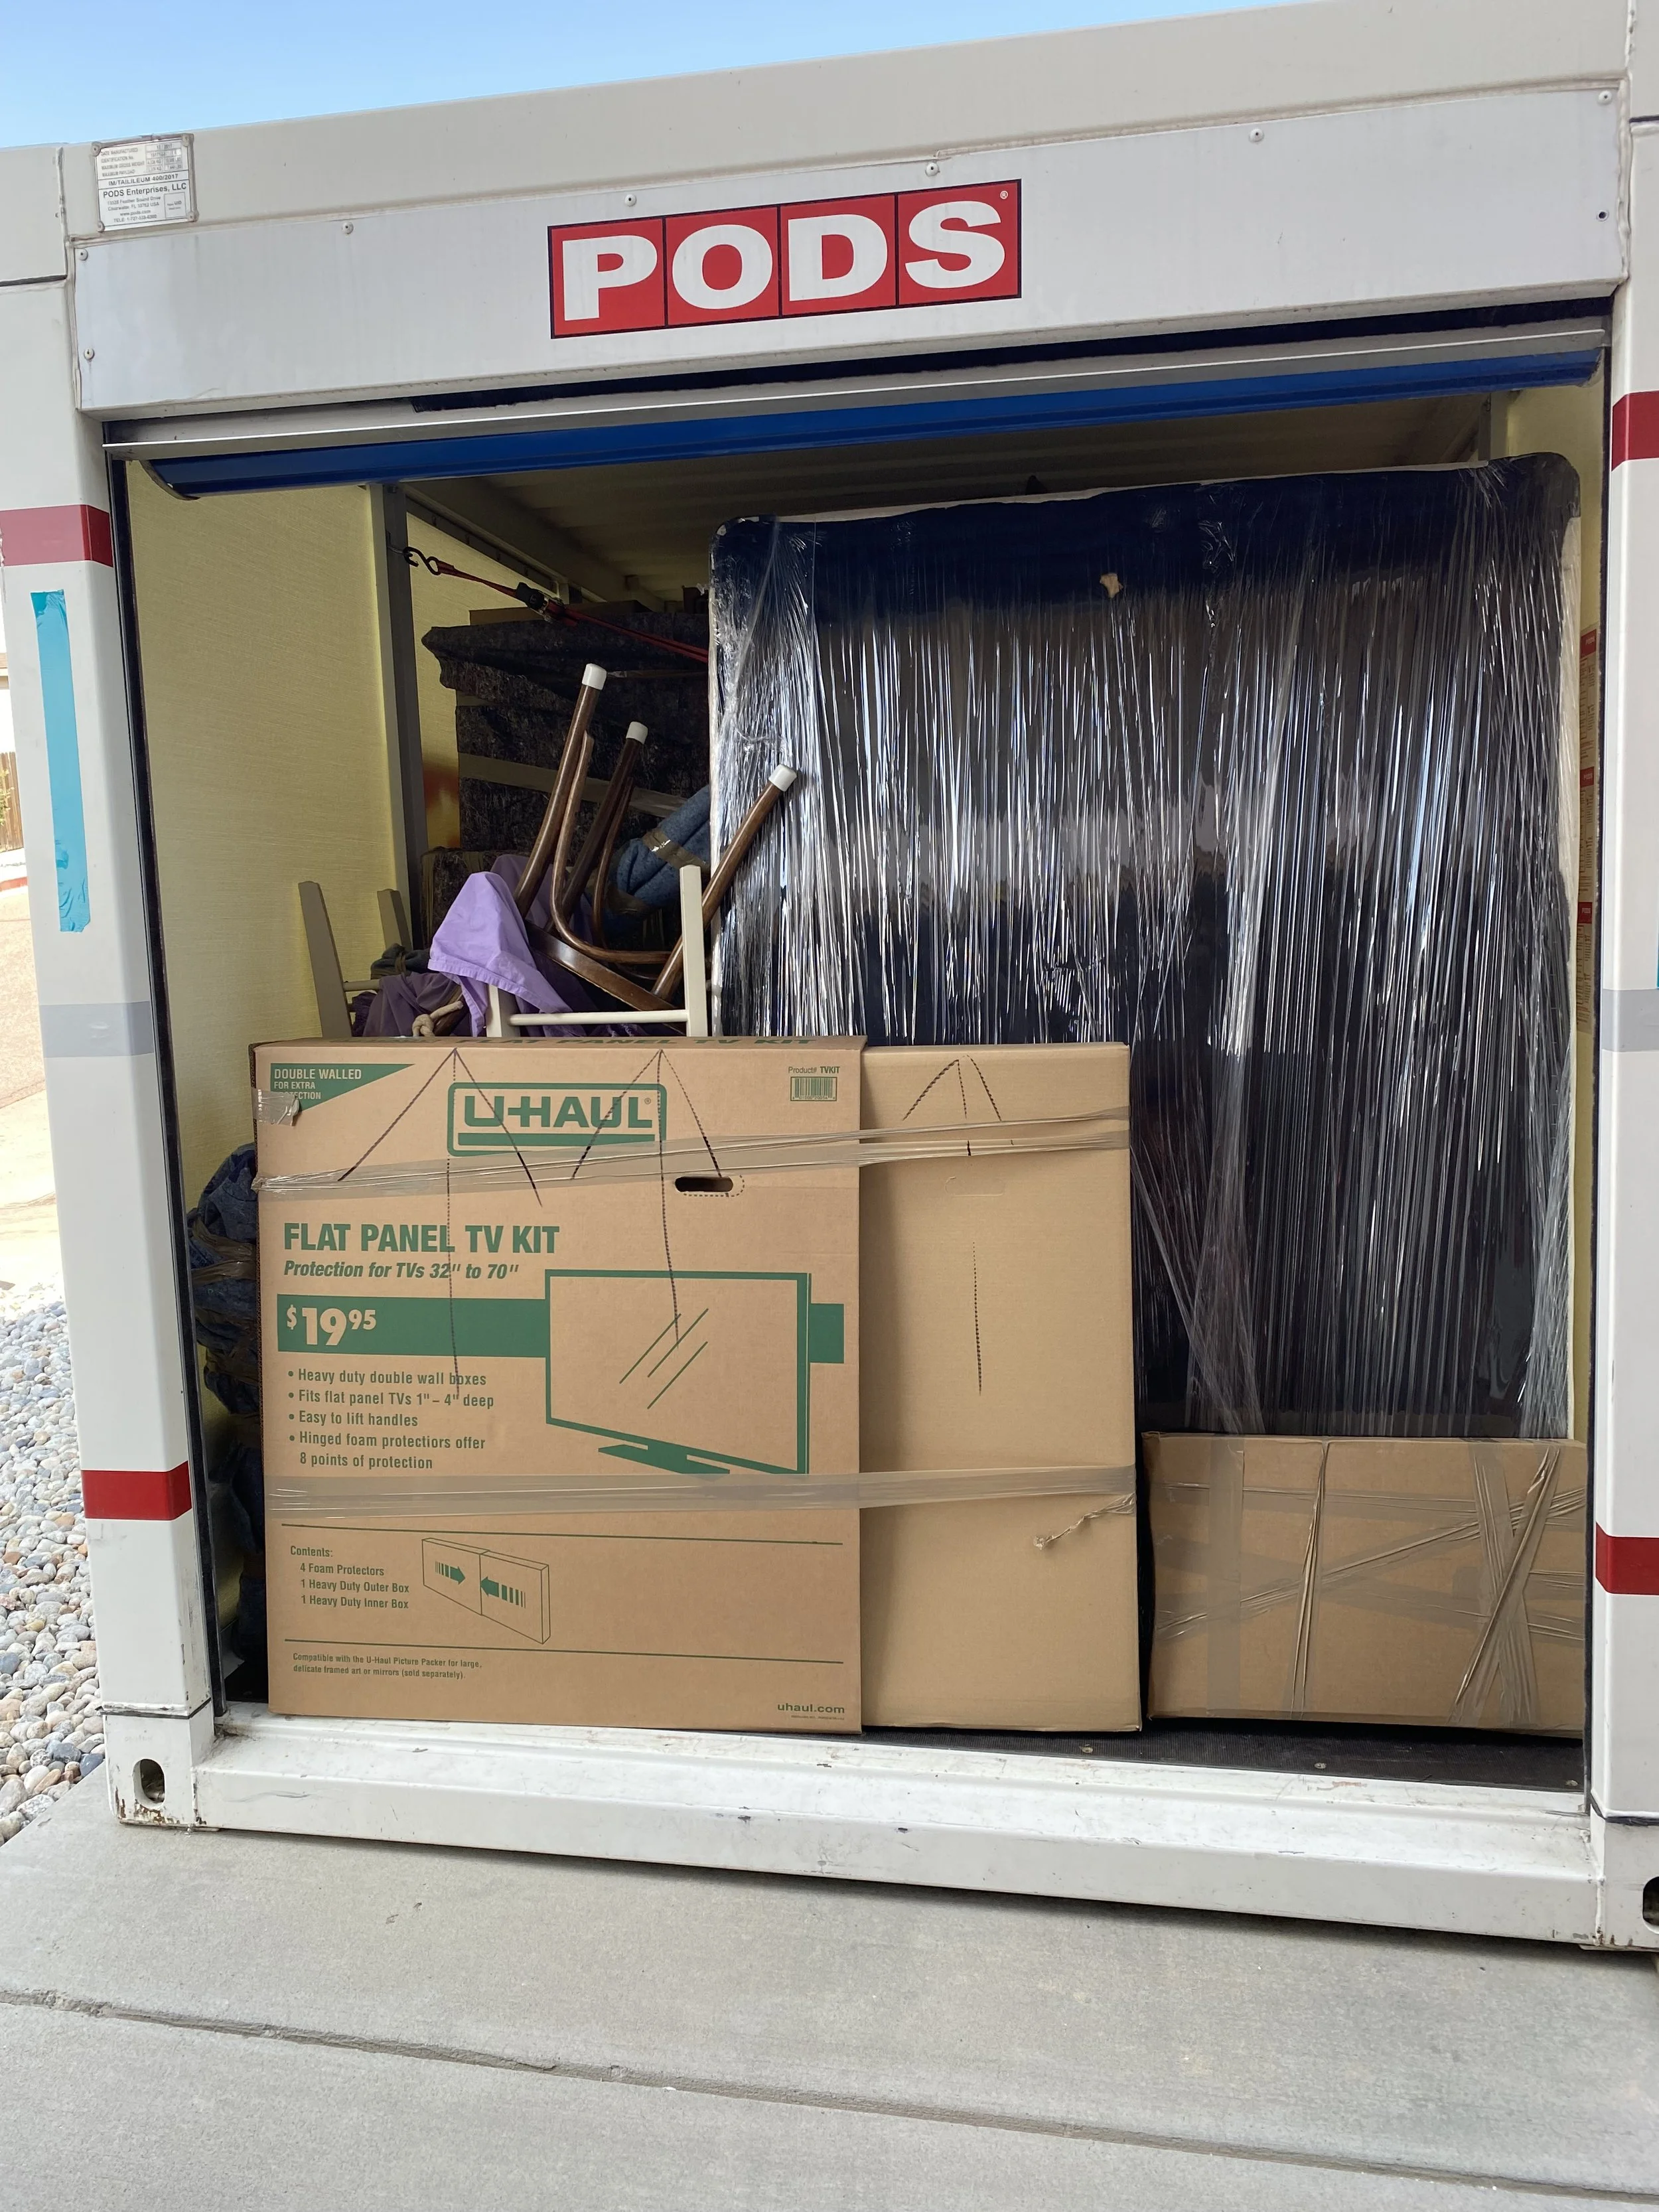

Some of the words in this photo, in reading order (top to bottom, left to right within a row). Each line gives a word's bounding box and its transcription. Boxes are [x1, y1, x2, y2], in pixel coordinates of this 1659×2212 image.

[103, 189, 124, 198] PODS
[127, 186, 170, 196] Enterprises,
[172, 183, 186, 191] LLC
[562, 200, 1005, 321] PODS
[274, 1069, 316, 1080] DOUBLE
[319, 1069, 362, 1080] WALLED
[273, 1081, 289, 1090] FOR
[291, 1081, 316, 1090] EXTRA
[465, 1096, 652, 1128] U-HAUL
[284, 1222, 351, 1251] FLAT
[360, 1224, 455, 1252] PANEL
[465, 1226, 504, 1254] TV
[512, 1226, 560, 1254] KIT
[284, 1260, 366, 1278] Protection
[368, 1261, 392, 1278] for
[396, 1262, 425, 1279] TVs
[465, 1264, 482, 1280] to
[298, 1368, 335, 1385] Heavy
[339, 1370, 365, 1386] duty
[370, 1370, 413, 1384] double
[417, 1372, 444, 1385] wall
[449, 1372, 487, 1386] boxes
[299, 1389, 321, 1403] Fits
[325, 1390, 345, 1404] flat
[350, 1392, 384, 1407] panel
[388, 1392, 411, 1405] TVs
[463, 1394, 494, 1410] deep
[299, 1410, 326, 1426] Easy
[330, 1412, 342, 1424] to
[346, 1412, 364, 1426] lift
[368, 1413, 418, 1426] handles
[299, 1432, 342, 1447] Hinged
[346, 1432, 378, 1447] foam
[455, 1436, 486, 1449] offer
[300, 1452, 307, 1465] 8
[311, 1453, 348, 1467] points
[352, 1454, 365, 1467] of
[368, 1455, 433, 1469] protection
[290, 1545, 333, 1558] Contents:
[300, 1563, 306, 1573] 4
[309, 1563, 334, 1575] Foam
[336, 1564, 385, 1577] Protectors
[301, 1579, 305, 1589] 1
[309, 1579, 338, 1593] Heavy
[339, 1580, 360, 1593] Duty
[364, 1582, 389, 1593] Outer
[392, 1582, 409, 1593] Box
[301, 1594, 306, 1605] 1
[309, 1595, 338, 1608] Heavy
[340, 1596, 361, 1609] Duty
[364, 1597, 388, 1609] Inner
[392, 1598, 409, 1609] Box
[293, 1653, 333, 1662] Compatible
[401, 1669, 420, 1678] (sold
[421, 1670, 465, 1679] separately).
[777, 1703, 845, 1714] uhaul.com
